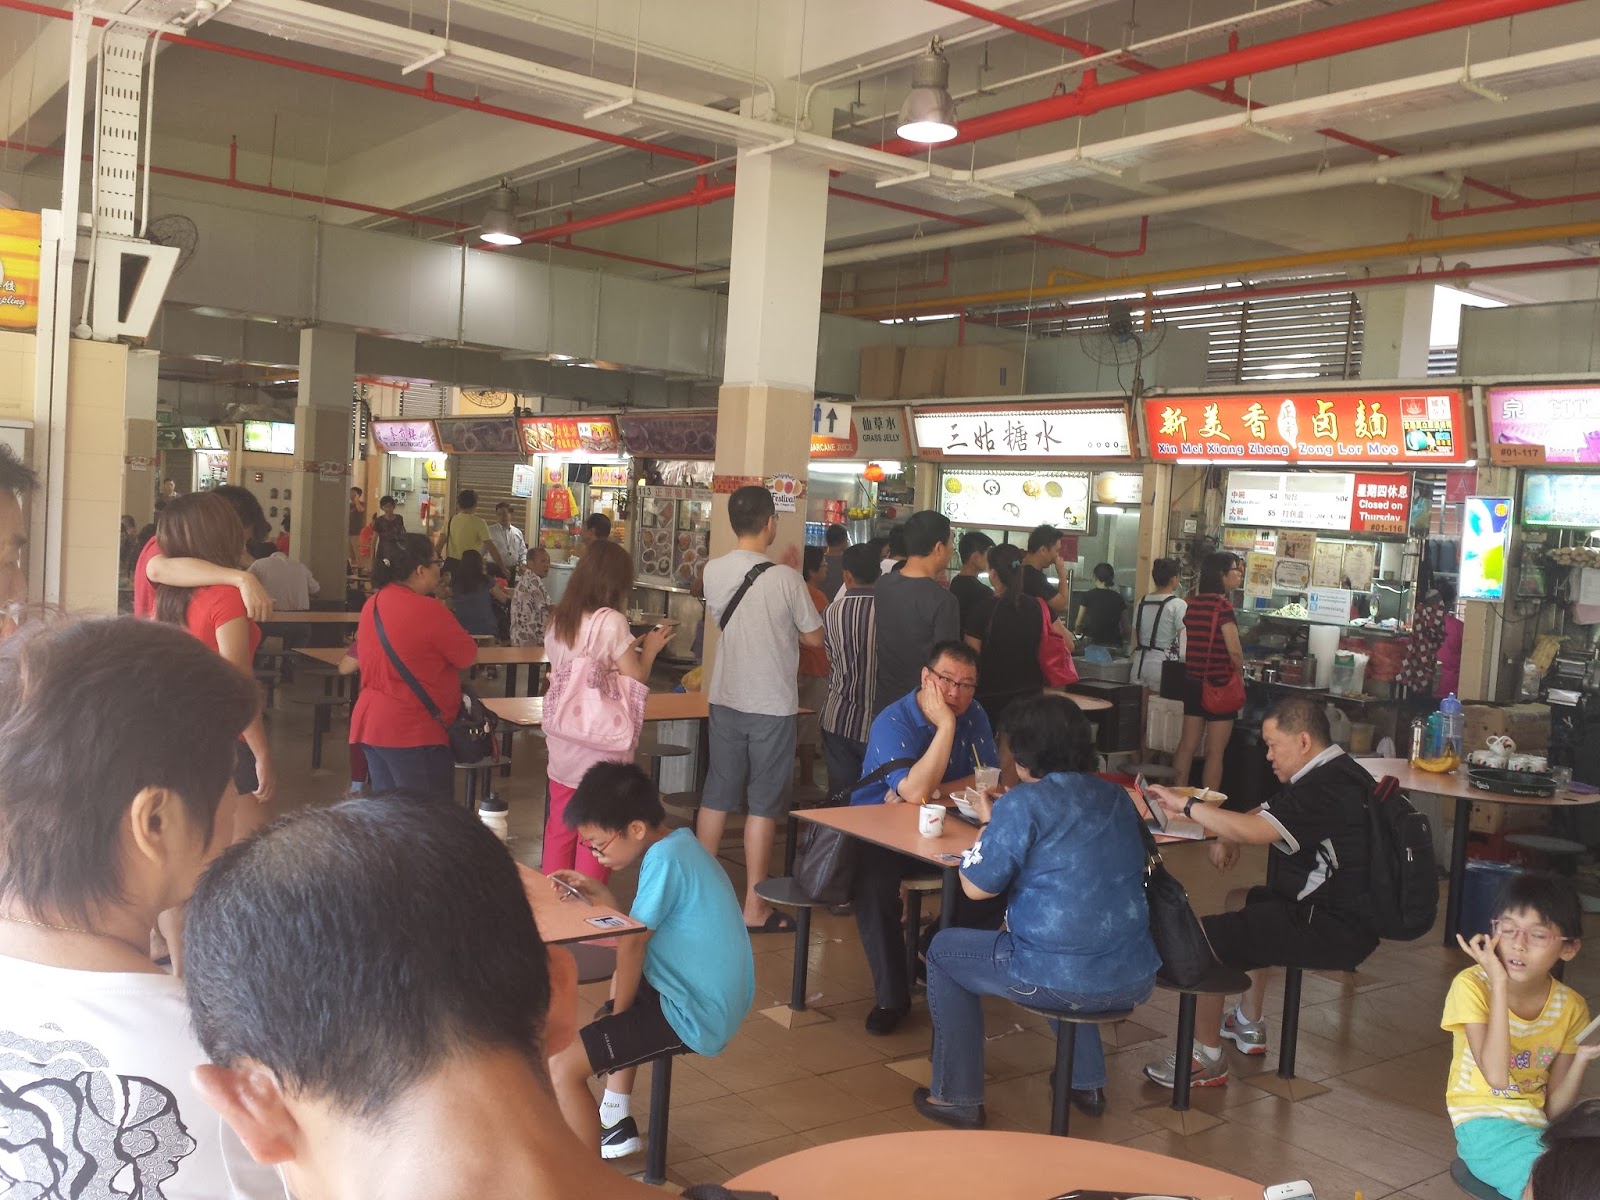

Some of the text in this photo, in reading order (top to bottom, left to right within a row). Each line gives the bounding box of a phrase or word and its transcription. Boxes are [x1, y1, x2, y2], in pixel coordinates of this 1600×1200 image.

[862, 416, 896, 431] 仙草水
[1159, 402, 1271, 442] 新美香
[862, 434, 900, 442] GRASS JELLY
[946, 419, 1063, 452] 三姑糖水
[836, 443, 853, 452] JUICE
[1158, 443, 1399, 456] Xin Mei Xiang Zheng Zong Lor Mee
[1500, 448, 1539, 457] #01-117
[638, 487, 652, 496] 113
[1357, 484, 1408, 499] 星期四休息
[1359, 500, 1403, 510] Closed on
[1229, 507, 1244, 516] 大碗
[1359, 511, 1401, 521] Thursday
[1370, 525, 1403, 533] #01-116
